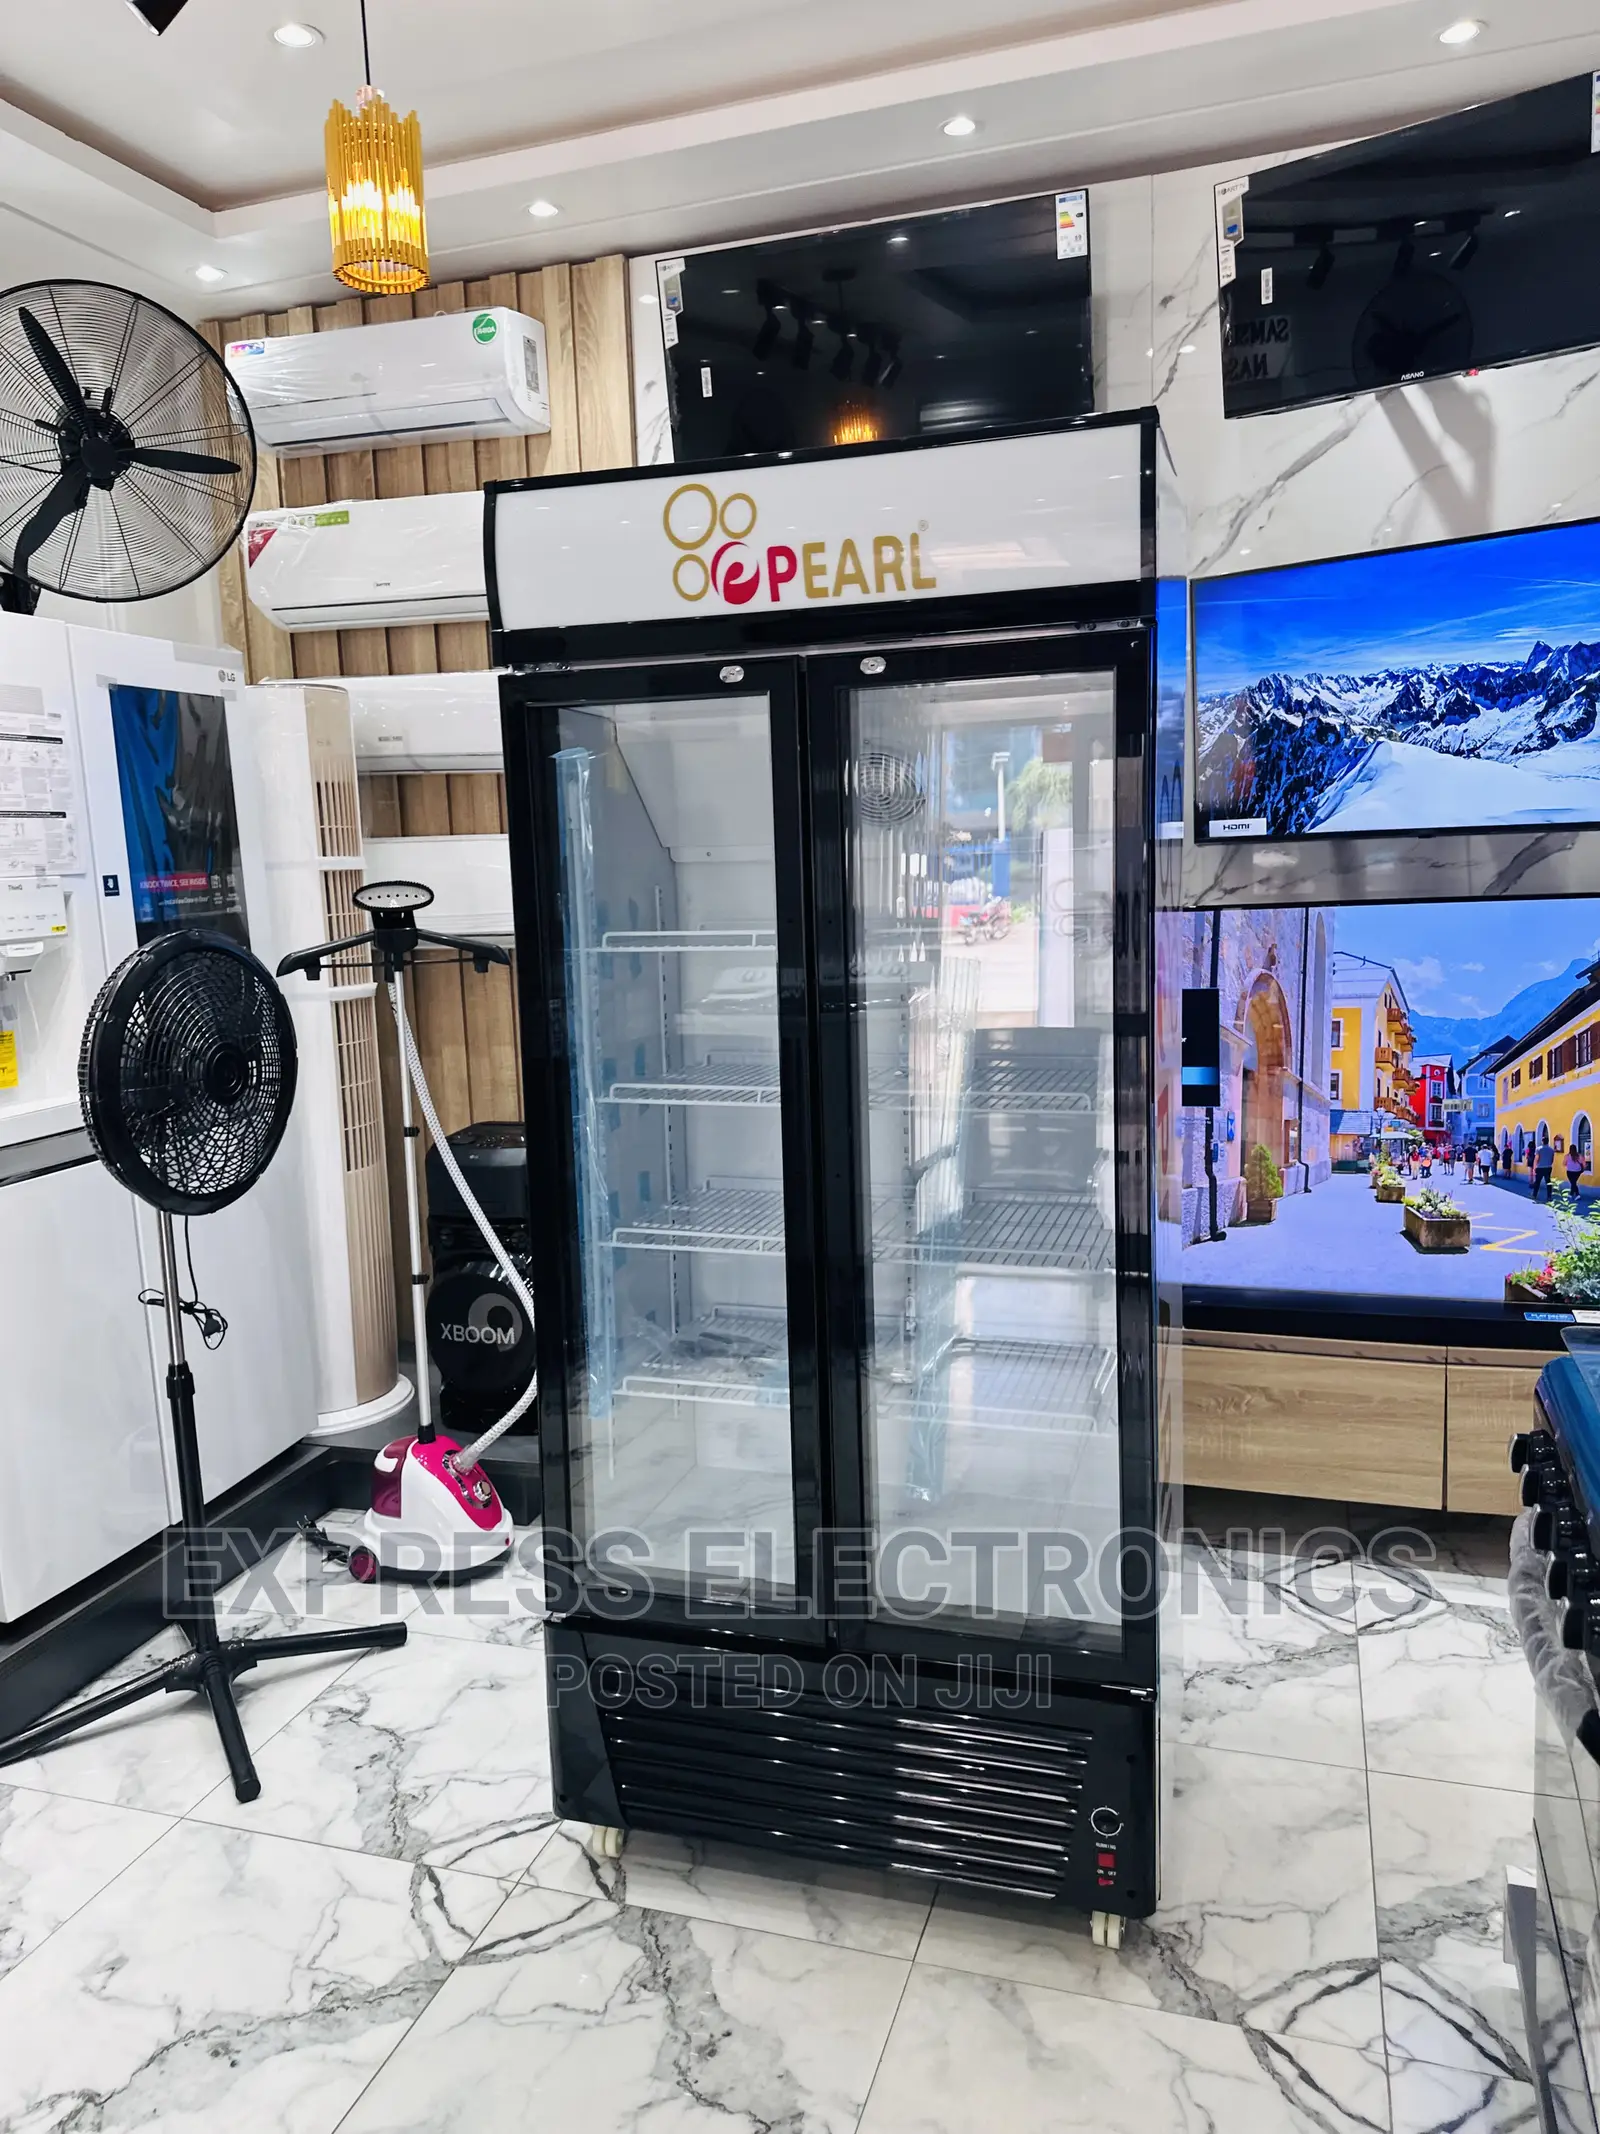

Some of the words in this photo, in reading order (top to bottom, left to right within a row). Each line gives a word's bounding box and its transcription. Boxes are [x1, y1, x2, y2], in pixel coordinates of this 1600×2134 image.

[1401, 370, 1425, 381] ASANO
[767, 532, 937, 603] PEARL
[226, 672, 236, 682] LG
[1222, 823, 1250, 831] HDMI
[440, 1323, 515, 1344] XBOOM
